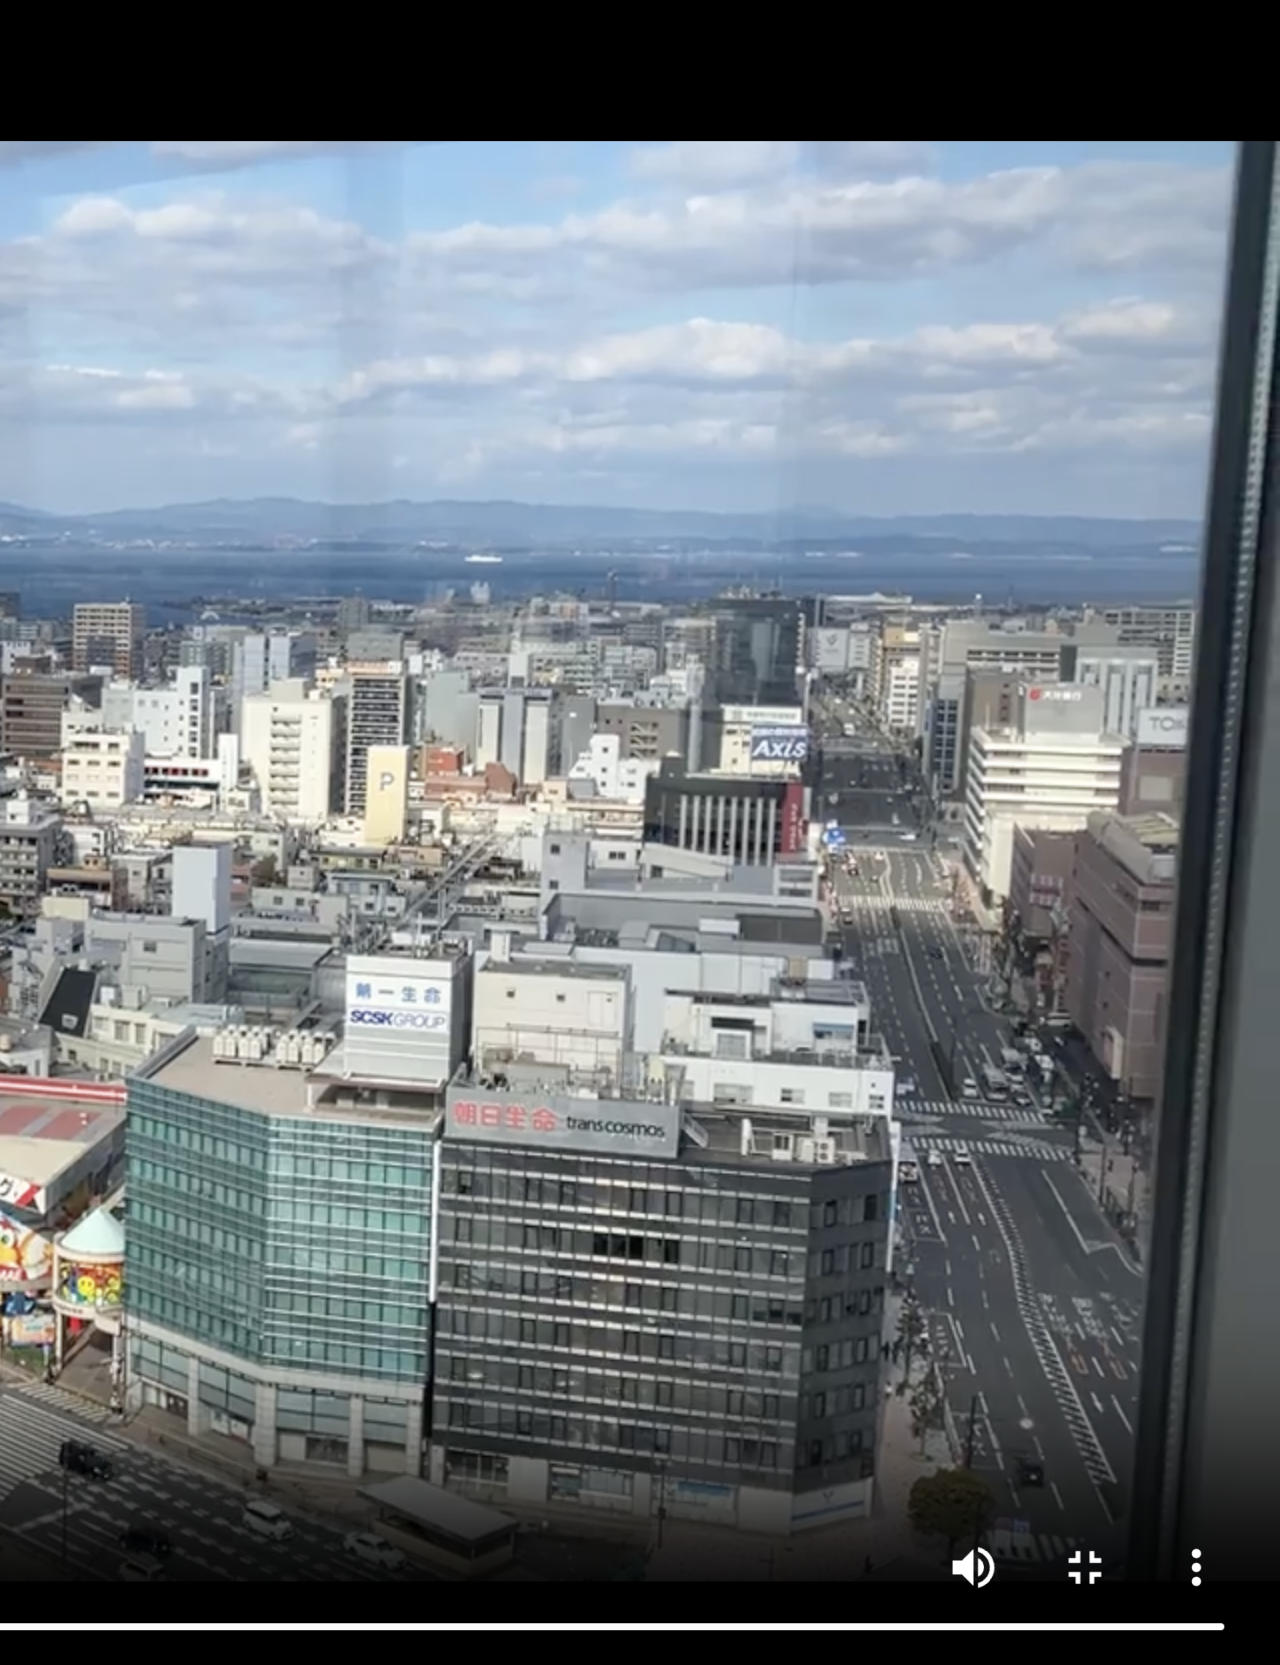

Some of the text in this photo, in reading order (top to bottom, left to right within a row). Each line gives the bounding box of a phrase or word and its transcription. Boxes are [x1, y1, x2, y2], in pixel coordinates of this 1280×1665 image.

[380, 771, 395, 791] P
[355, 982, 442, 1005] 第一生命
[453, 1102, 558, 1133] 朝日生命
[566, 1115, 666, 1138] transcosmos
